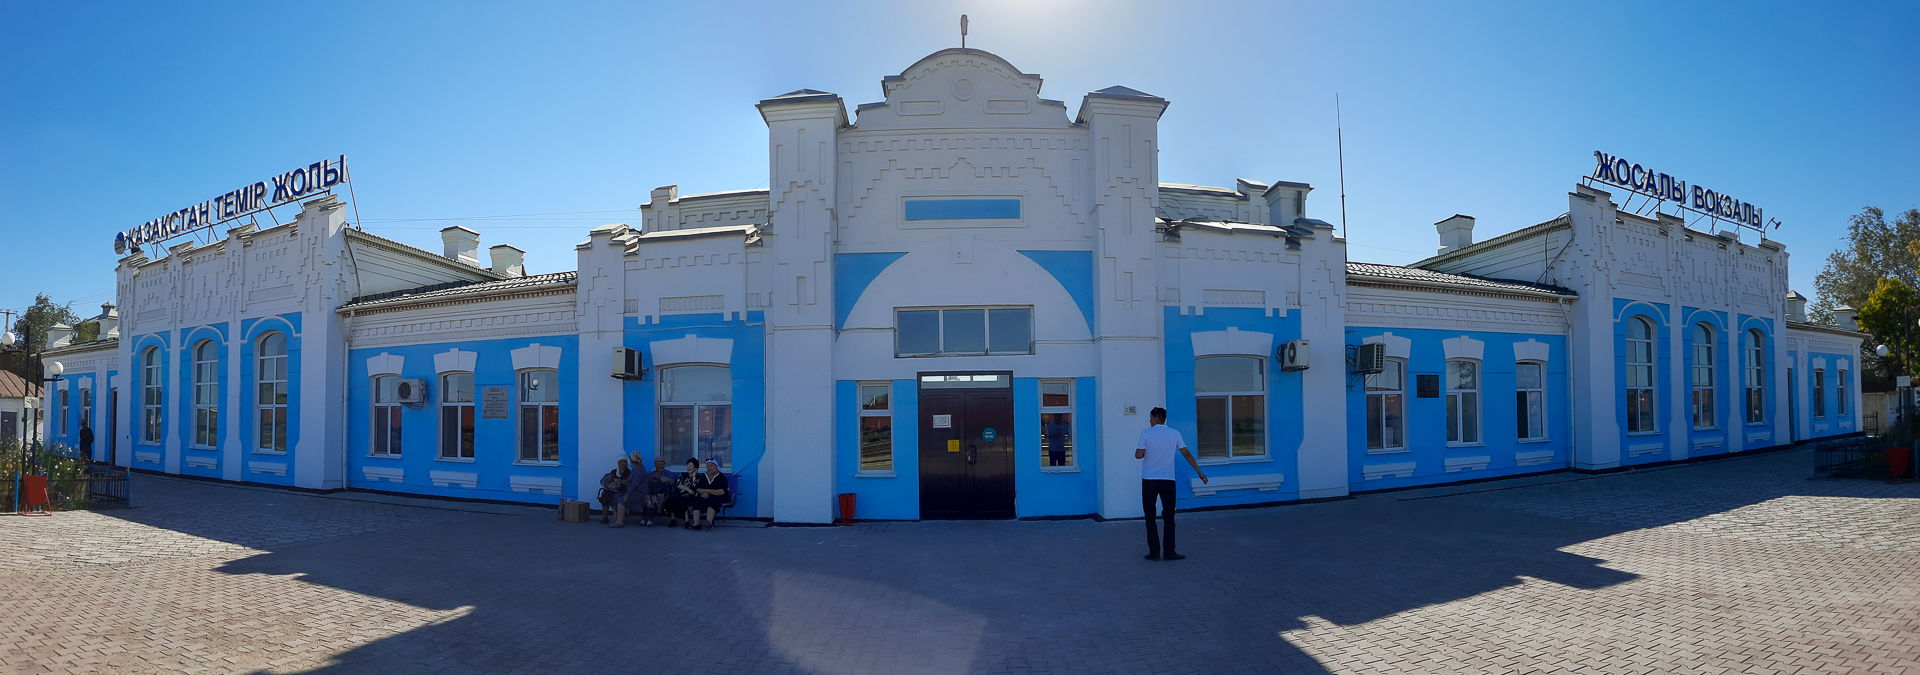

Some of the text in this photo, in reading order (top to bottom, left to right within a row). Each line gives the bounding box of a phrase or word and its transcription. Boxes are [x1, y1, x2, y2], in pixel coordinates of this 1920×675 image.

[214, 181, 268, 220] ТЕМІР
[272, 154, 347, 203] ЖОЛЫ
[1594, 150, 1763, 228] ЖОСАЛЫ ВОКЗАЛЫ
